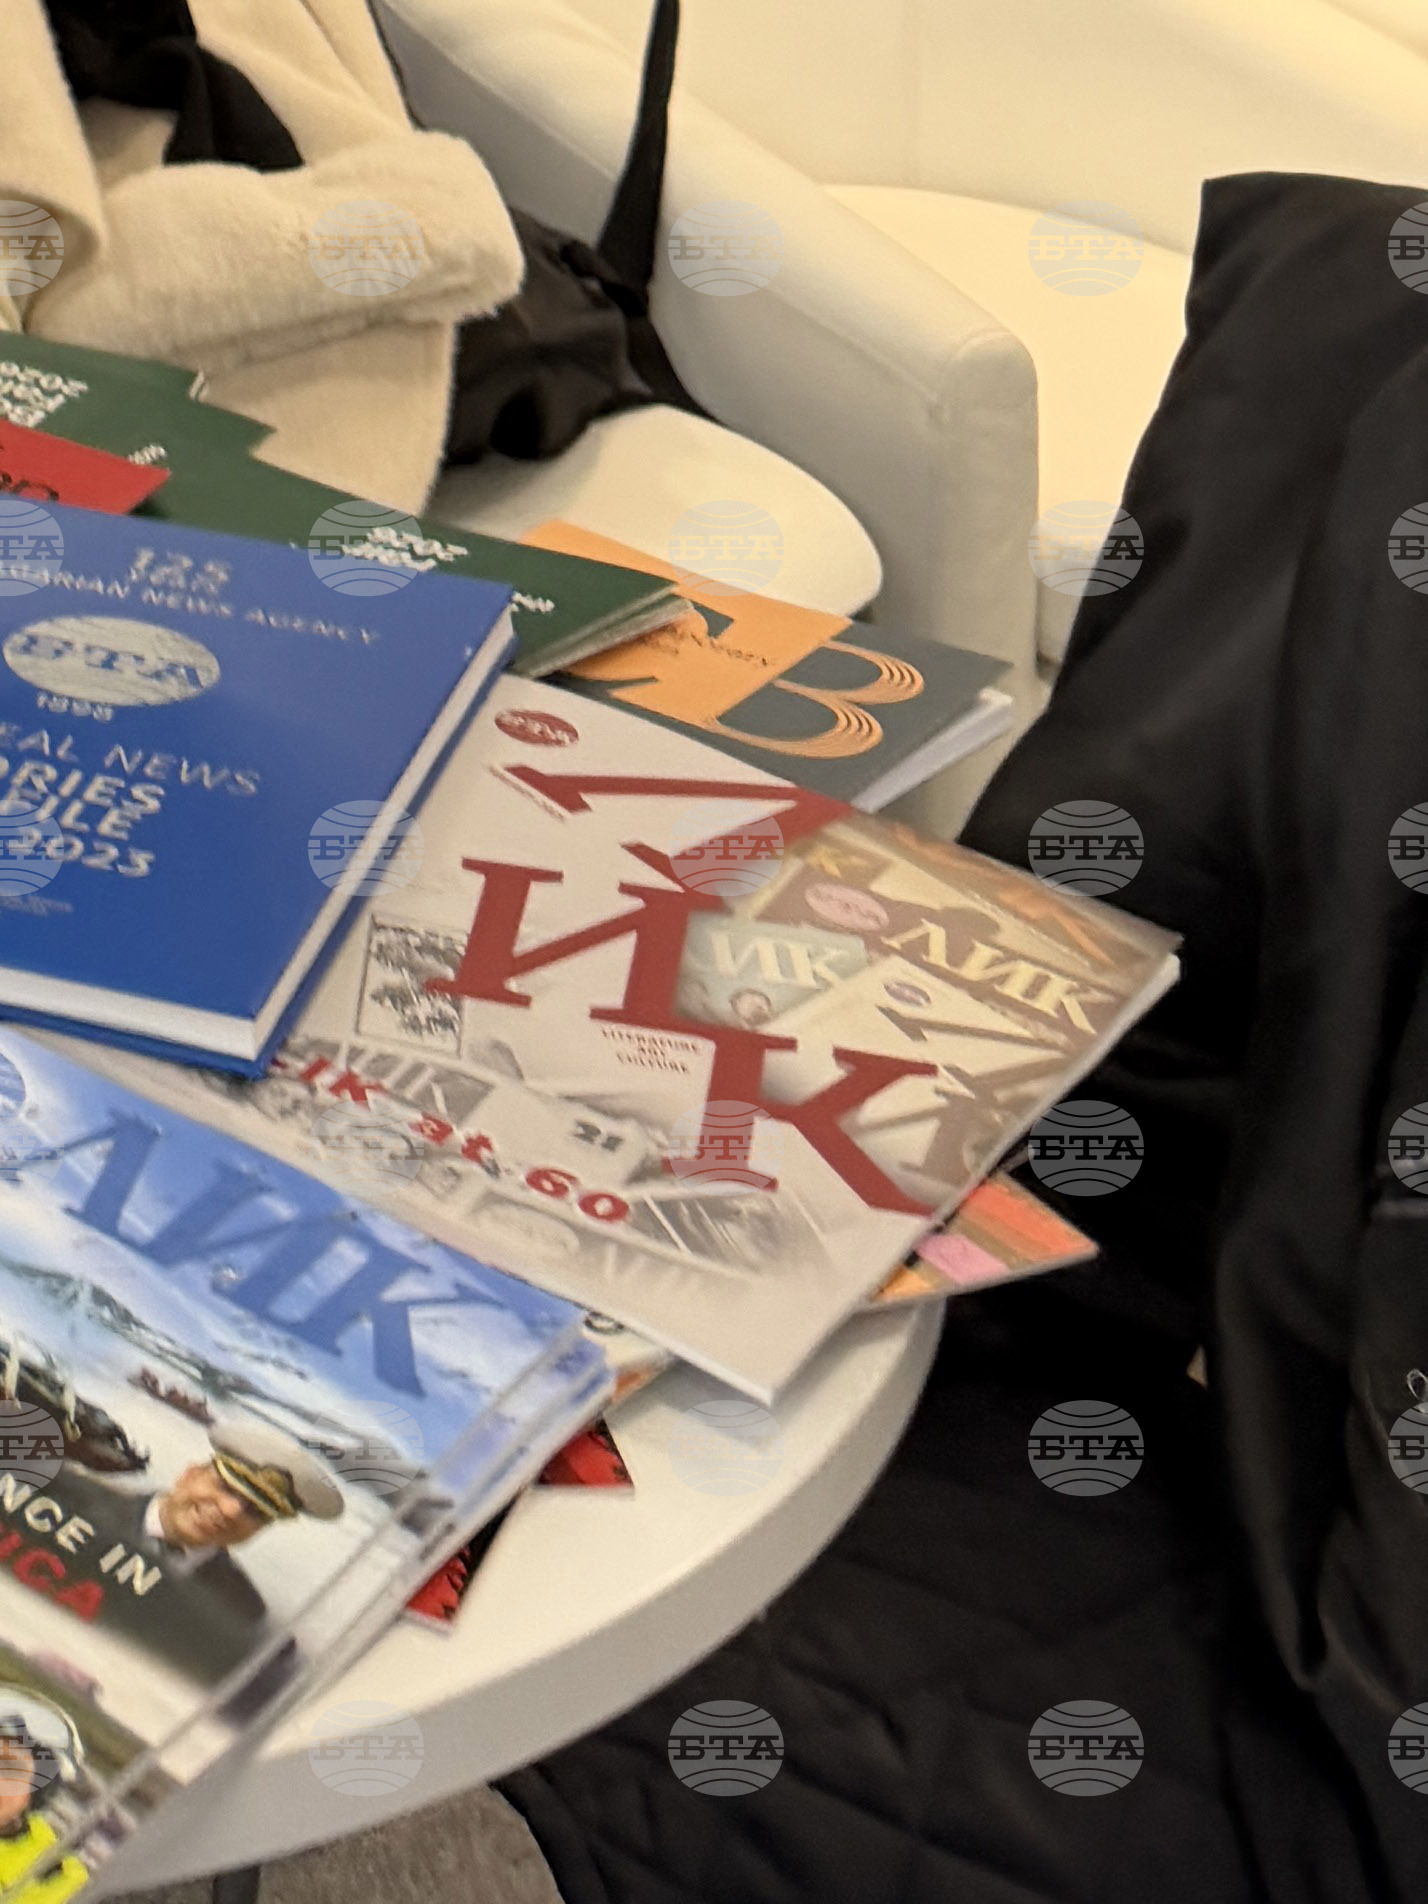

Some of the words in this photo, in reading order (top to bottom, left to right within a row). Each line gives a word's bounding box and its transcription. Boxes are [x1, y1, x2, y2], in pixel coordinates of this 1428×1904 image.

[103, 744, 262, 796] NEWS
[5, 831, 157, 879] 2023
[883, 919, 1119, 1036] ЛИК
[410, 1109, 494, 1167] at
[524, 1165, 632, 1226] 60
[98, 1540, 164, 1597] IN
